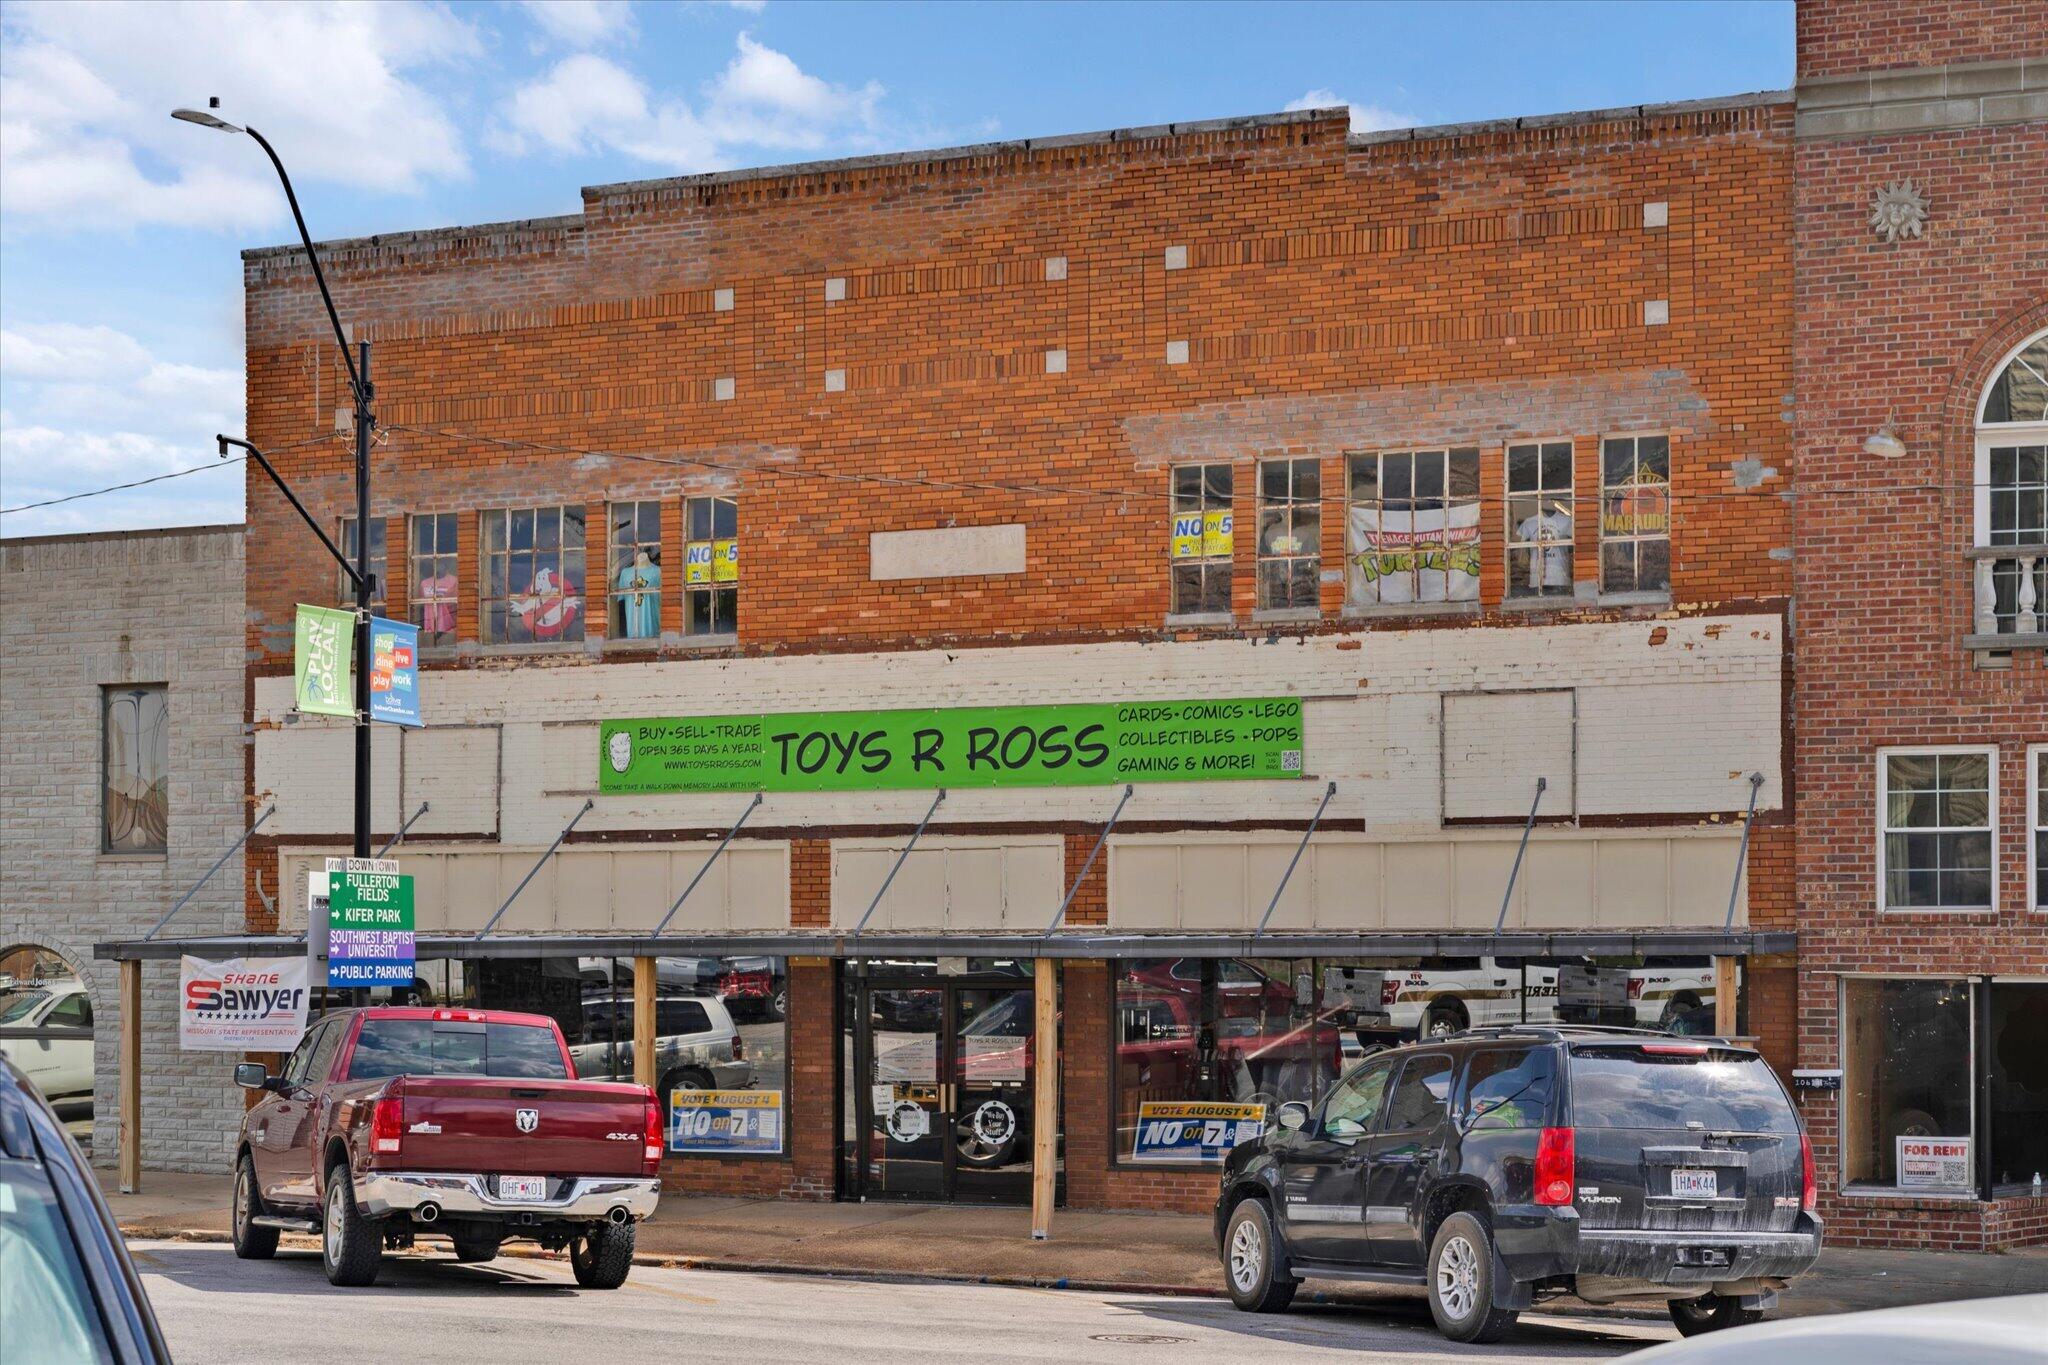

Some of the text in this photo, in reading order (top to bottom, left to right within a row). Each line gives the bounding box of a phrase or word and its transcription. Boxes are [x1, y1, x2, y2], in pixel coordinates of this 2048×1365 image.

[1175, 516, 1232, 537] NO ON 5
[1448, 528, 1479, 541] NINJA
[688, 544, 738, 564] NO ON 5
[308, 618, 323, 675] PLAY
[375, 634, 393, 652] shop
[322, 622, 337, 705] LOCAL
[376, 655, 393, 669] dine
[395, 650, 409, 665] live
[373, 673, 390, 690] play
[391, 673, 412, 687] work
[1118, 702, 1299, 723] CARDS COMICS LEGO
[639, 724, 761, 741] BUY SELL TRADE
[1118, 727, 1299, 747] COLLECTIBLES POPS
[639, 743, 762, 757] OPEN 365 DAYS A YEAR!
[771, 723, 1111, 777] TOYS R ROSS
[664, 760, 762, 770] WWW.TOYSRROSS.COM
[1117, 754, 1256, 773] GAMING & MORE!
[346, 874, 400, 889] FULLERTON
[357, 888, 389, 902] FIELDS
[345, 908, 401, 923] KIFER PARK
[330, 930, 415, 945] SOUTHWEST BAPTIST
[347, 944, 398, 959] UNIVERSITY
[340, 965, 413, 979] PUBLIC PARKING
[186, 980, 303, 1019] Sawyer
[682, 1095, 770, 1105] VOTE AUGUST 4
[1152, 1106, 1252, 1116] VOTE AUGUST 4
[677, 1110, 712, 1136] NO
[712, 1116, 730, 1132] on
[732, 1117, 744, 1134] 7
[748, 1118, 758, 1131] &
[1142, 1121, 1183, 1145] NO
[1183, 1127, 1202, 1140] on
[1207, 1128, 1219, 1144] 7
[1225, 1128, 1235, 1140] &
[1904, 1145, 1967, 1156] FOR RENT
